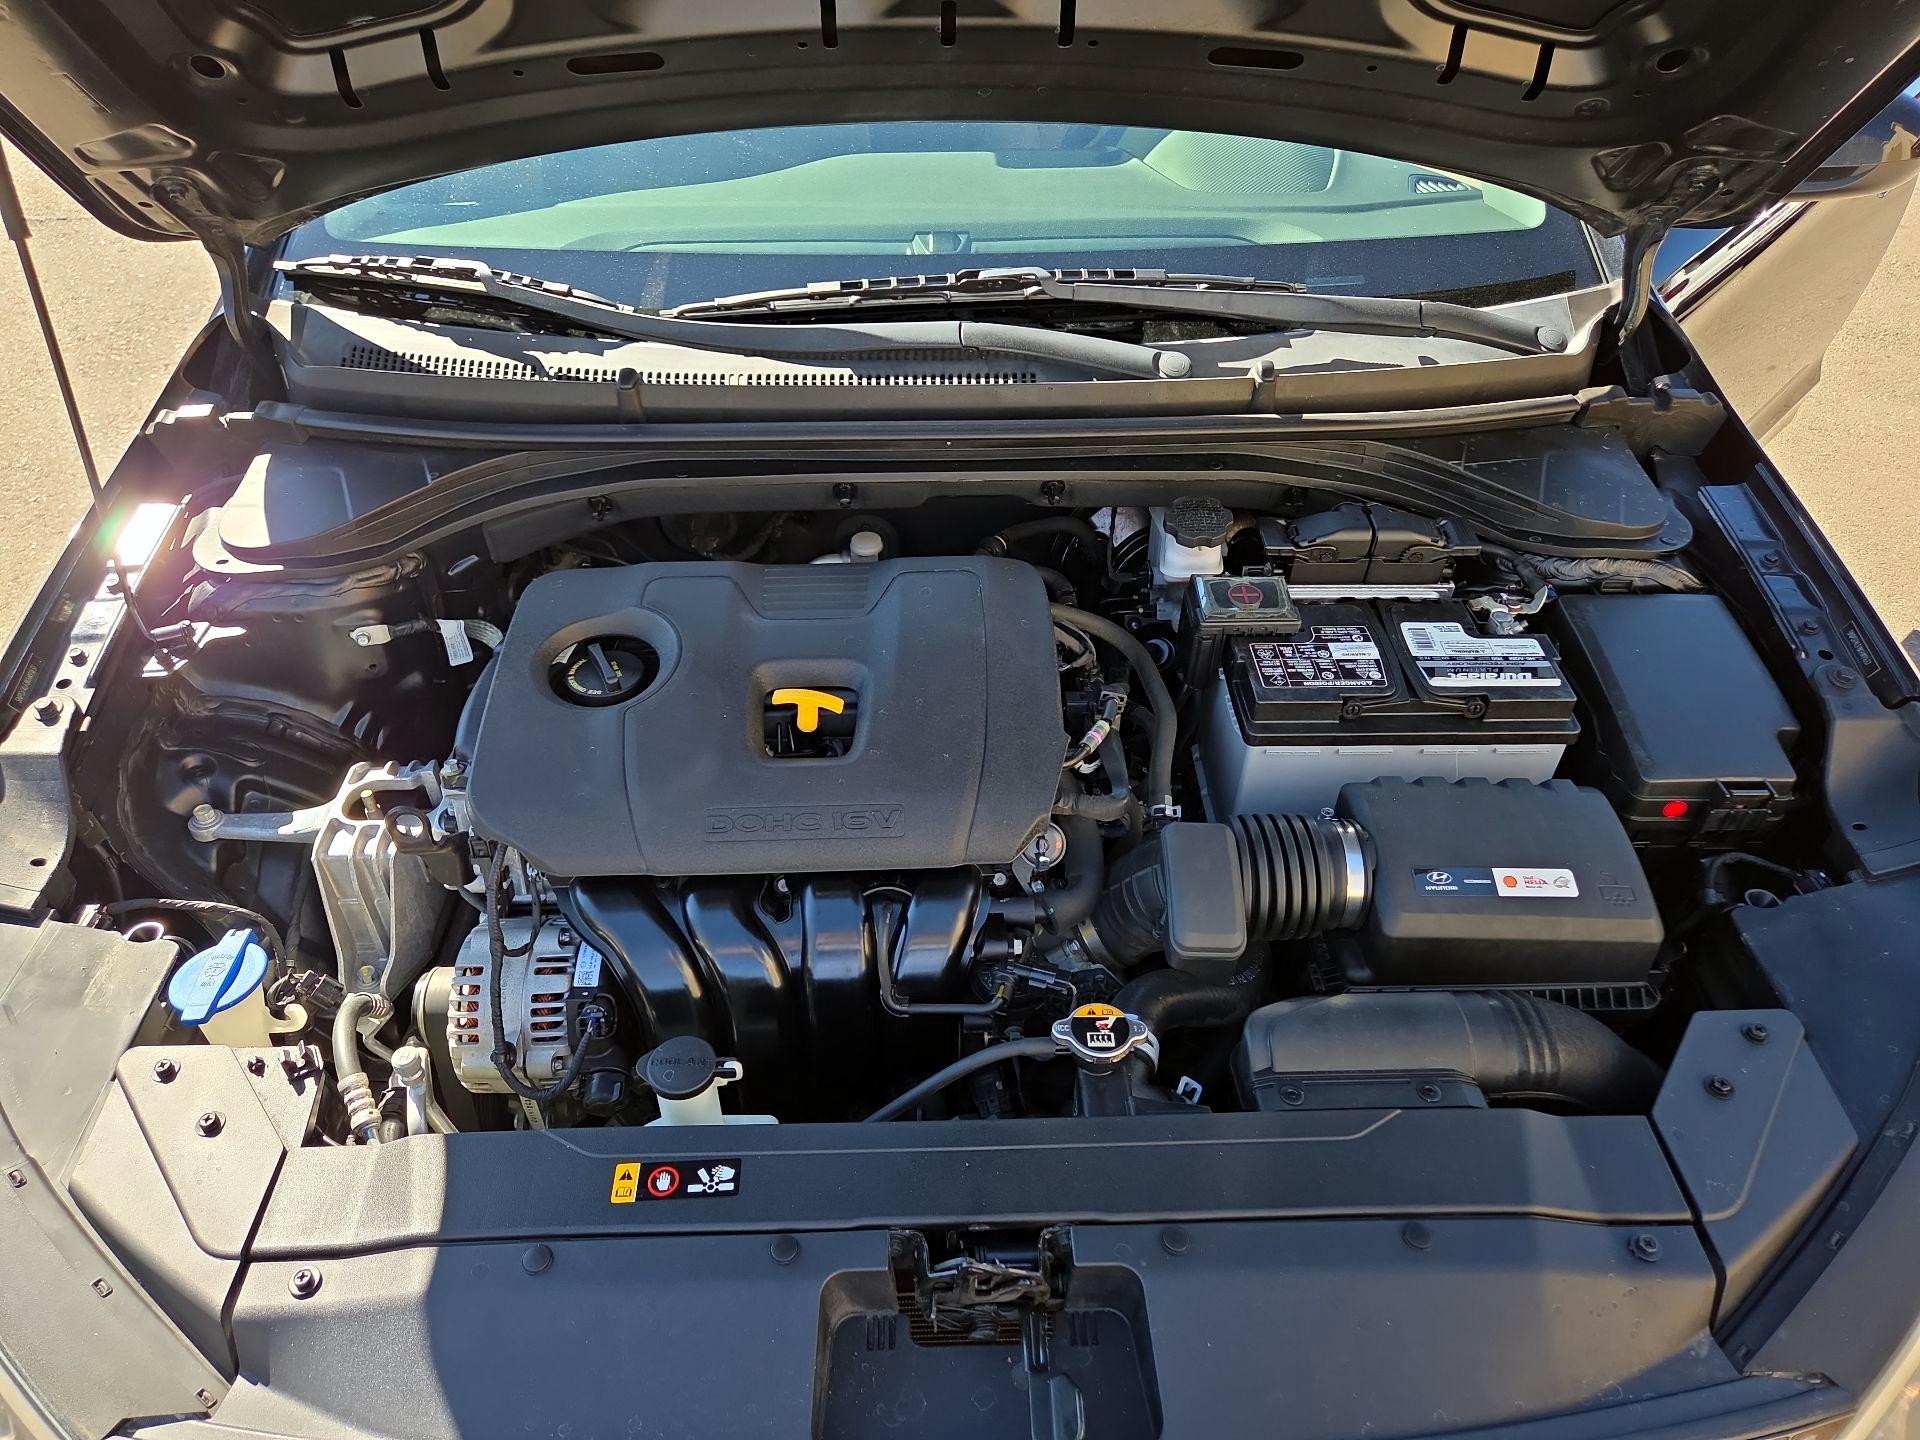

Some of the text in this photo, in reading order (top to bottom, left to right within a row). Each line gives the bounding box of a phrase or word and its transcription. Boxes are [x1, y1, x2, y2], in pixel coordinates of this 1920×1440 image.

[1447, 672, 1532, 681] Duralast
[705, 809, 900, 834] DOHC 16V
[650, 1056, 712, 1068] COOLANT
